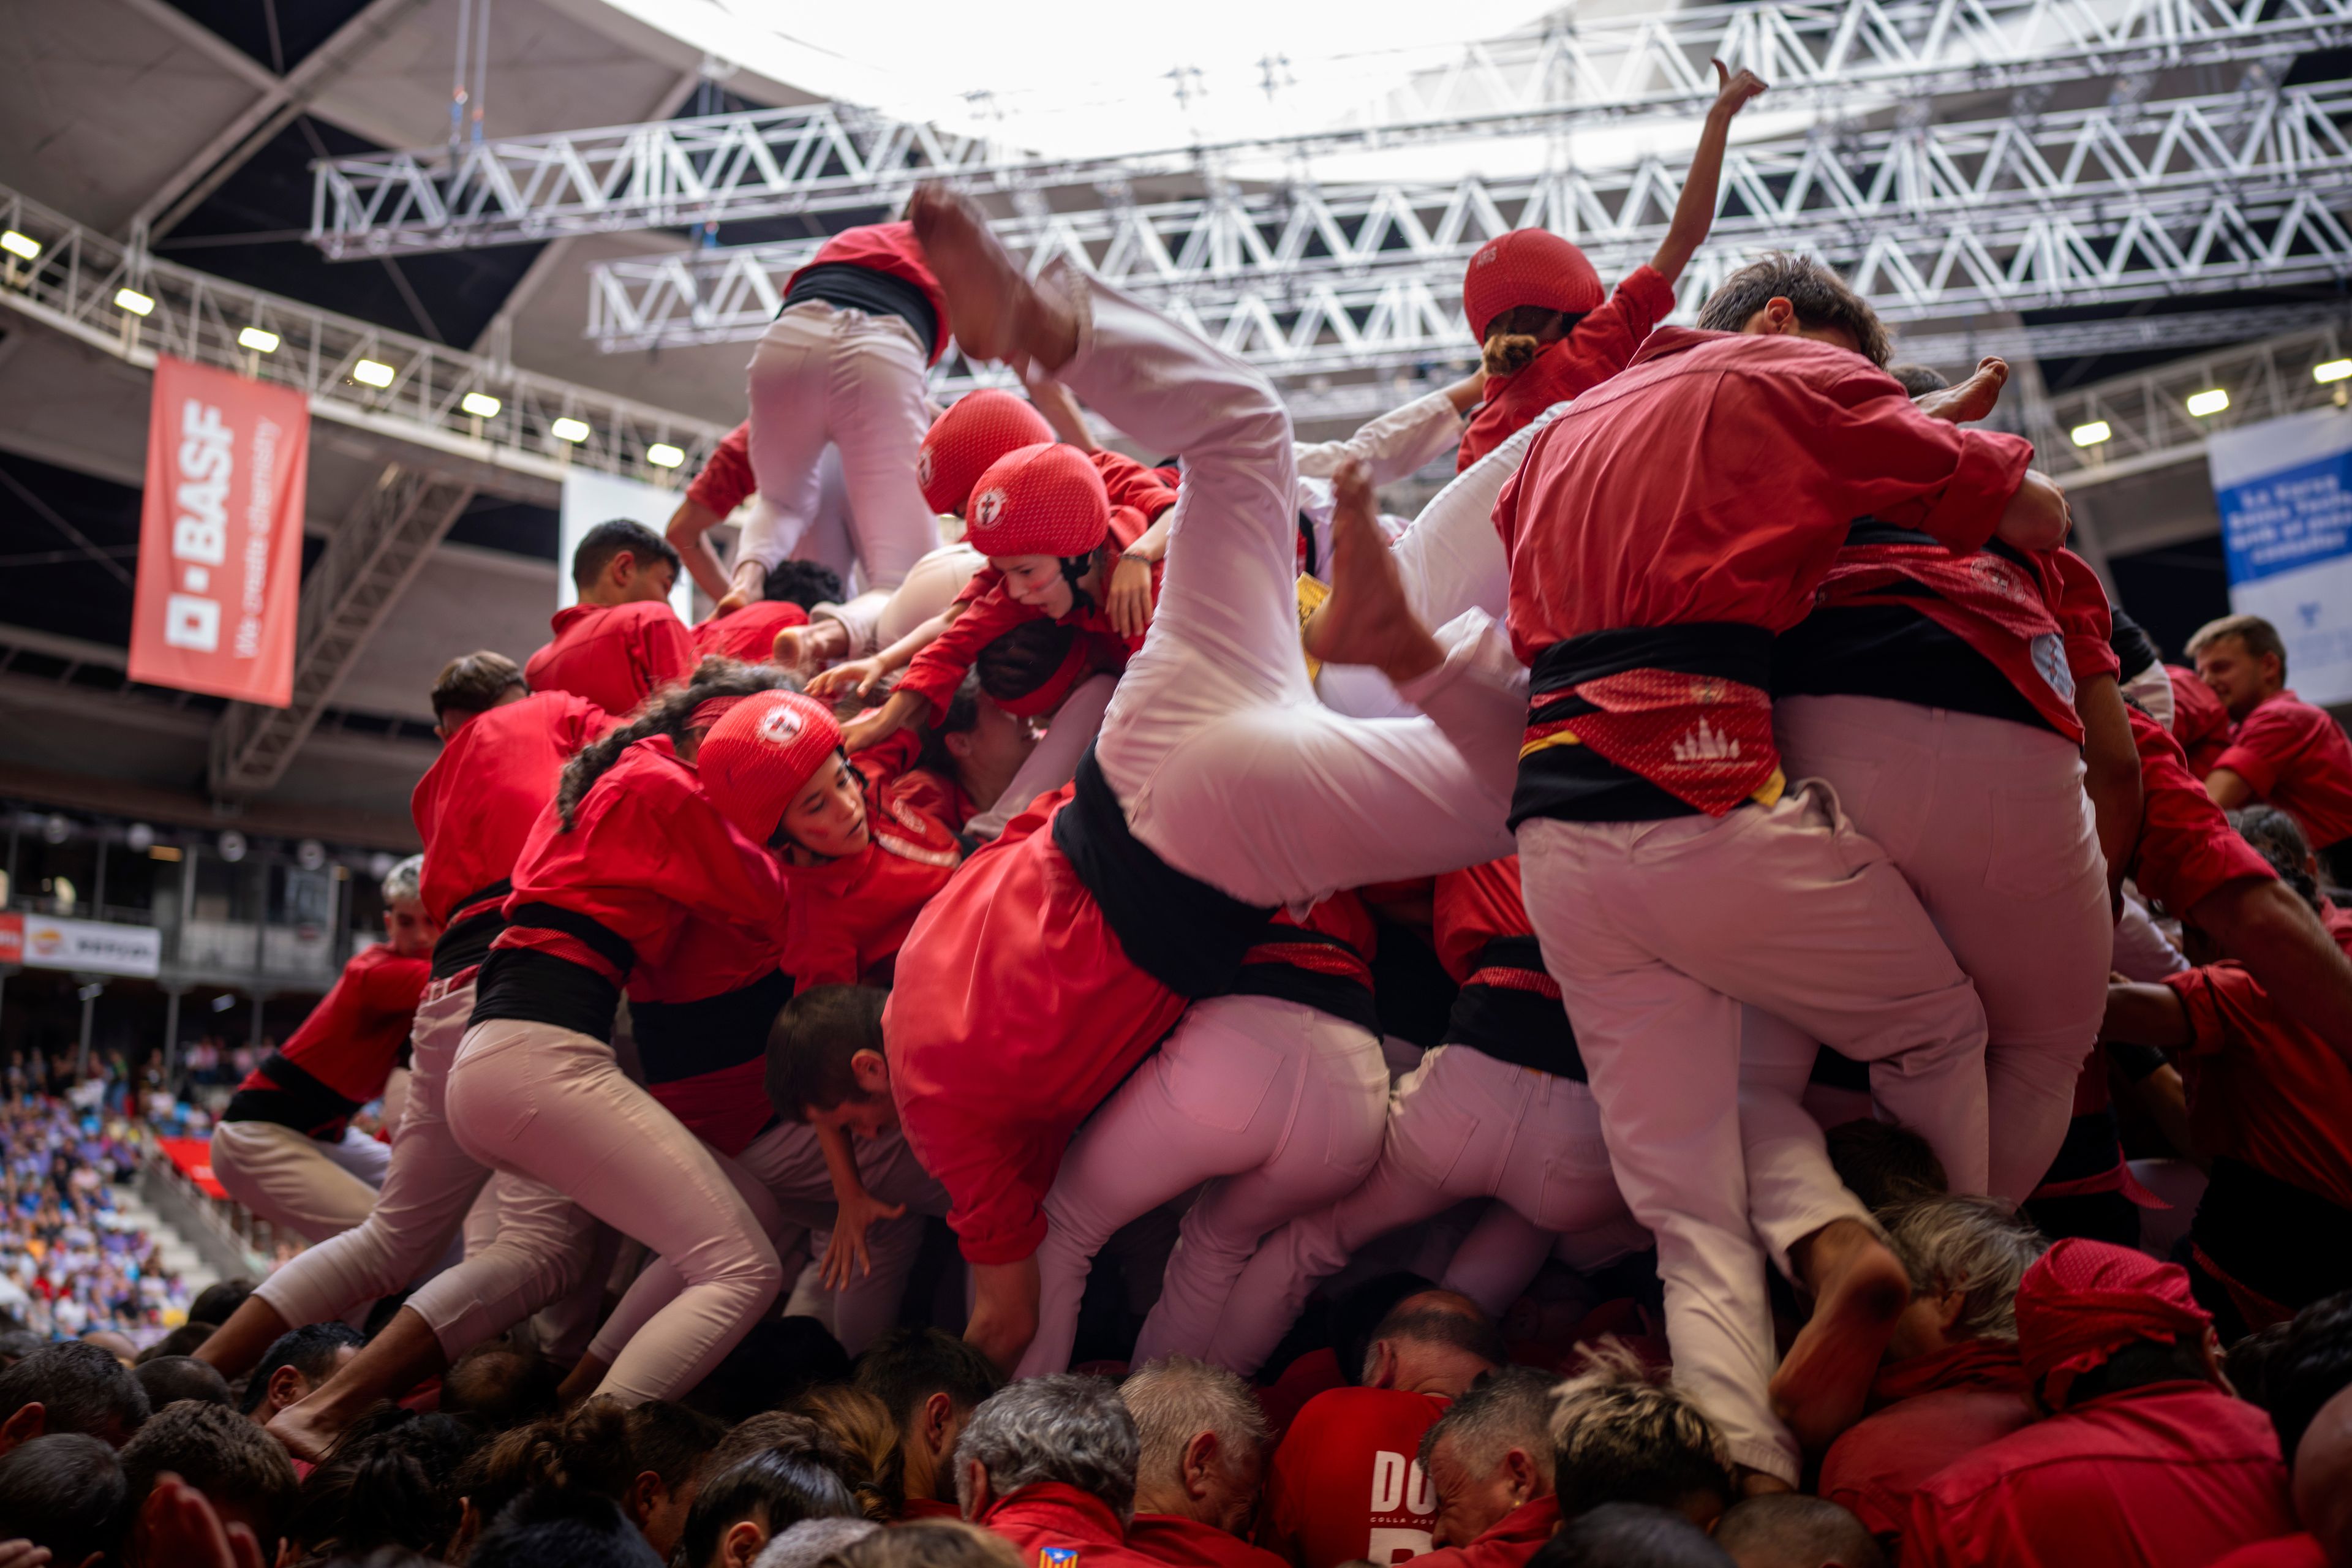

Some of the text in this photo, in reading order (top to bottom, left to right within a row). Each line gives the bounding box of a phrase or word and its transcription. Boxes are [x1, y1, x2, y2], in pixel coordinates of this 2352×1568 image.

[172, 398, 235, 566] BASF
[235, 415, 282, 659] We create chemistry
